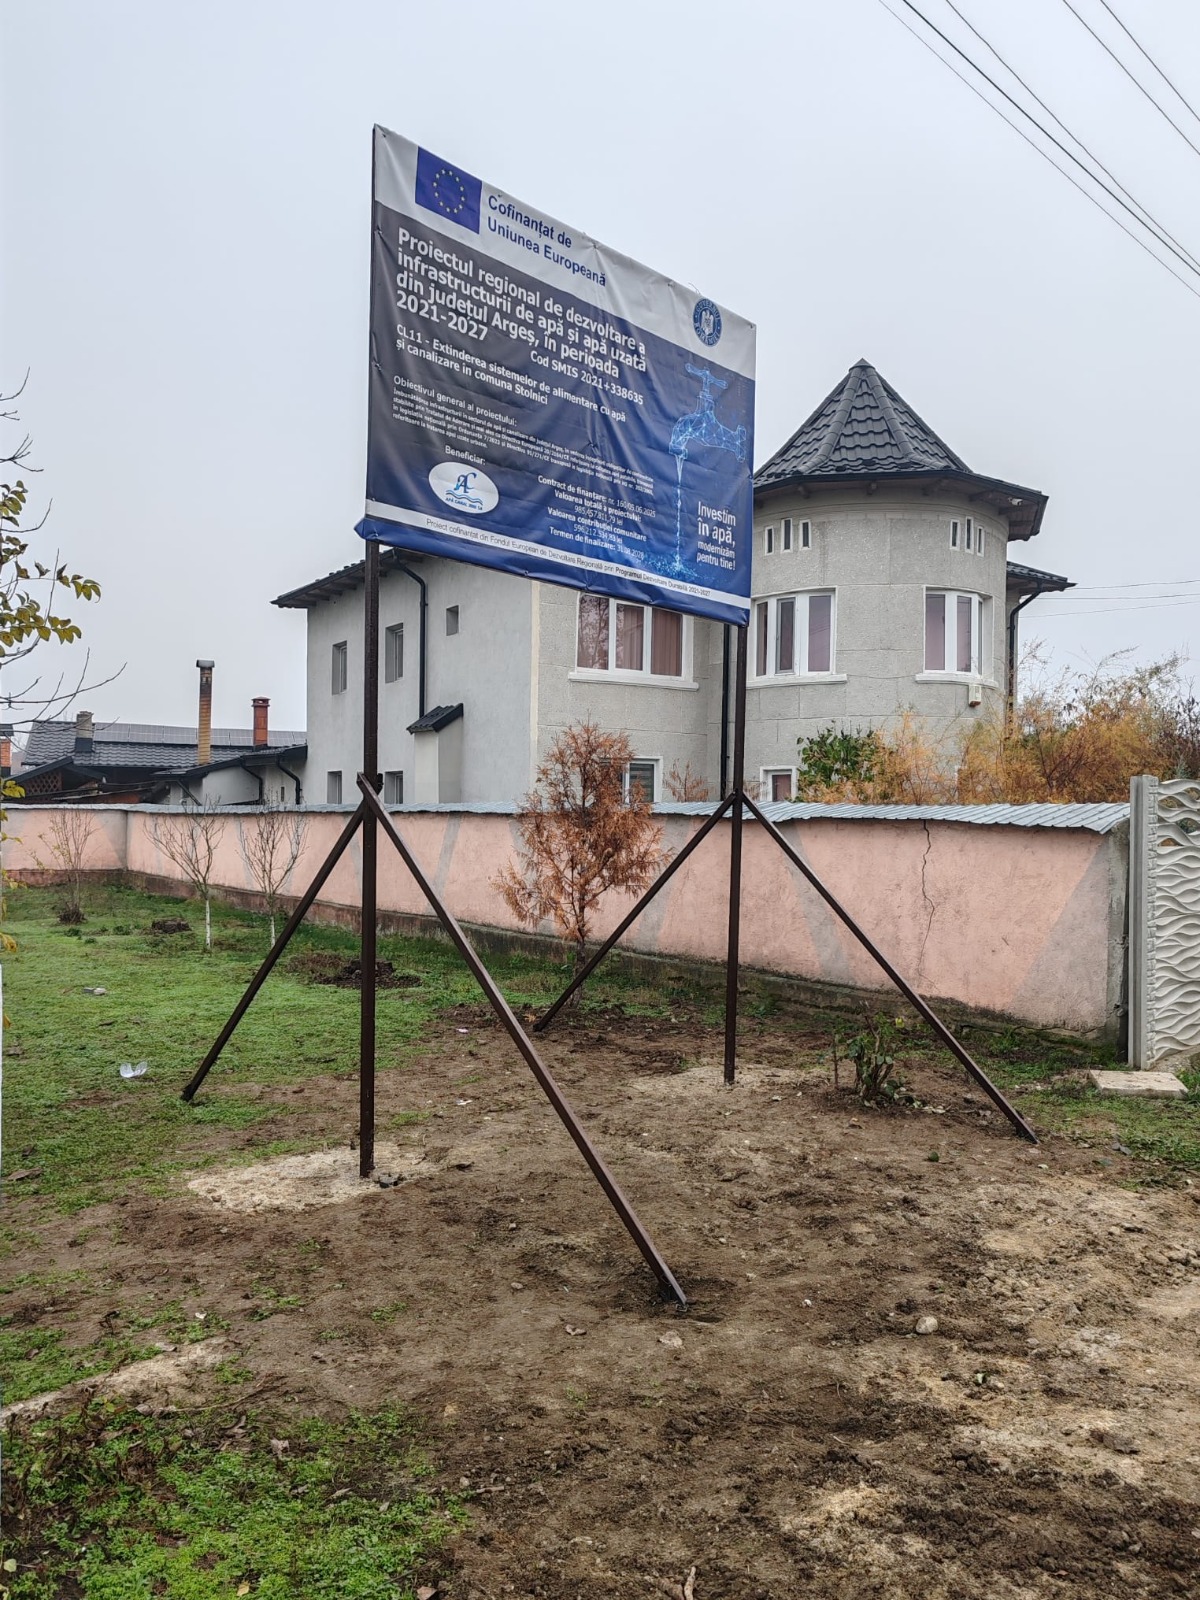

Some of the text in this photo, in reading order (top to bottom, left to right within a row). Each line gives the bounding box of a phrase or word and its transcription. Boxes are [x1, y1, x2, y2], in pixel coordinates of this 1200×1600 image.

[488, 195, 571, 248] Cofinanțat de
[487, 216, 605, 286] Uniunea Europeană
[397, 249, 646, 371] infrastructurii de apă și apă uzată
[398, 228, 472, 276] Proiectul
[478, 269, 540, 306] regional
[544, 297, 562, 317] de
[565, 308, 635, 349] dezvoltare
[396, 290, 488, 339] 2021-2027
[396, 270, 618, 377] din județul Argeș, în perioada
[396, 338, 404, 350] și
[407, 344, 460, 371] canalizare
[474, 370, 512, 391] comuna
[514, 383, 547, 404] Stolnici
[396, 323, 422, 343] CL11
[433, 339, 486, 368] Extinderea
[488, 363, 537, 387] sistemelor
[539, 381, 550, 394] de
[552, 387, 597, 411] alimentare
[599, 405, 609, 416] cu
[611, 410, 625, 422] apă
[530, 350, 643, 405] Cod SMIS 2021+338635
[393, 375, 434, 397] Obiectivul
[436, 392, 465, 408] general
[476, 406, 517, 426] proiectului:
[445, 445, 485, 465] Beneficiar:
[538, 475, 565, 490] Contract
[567, 484, 575, 493] de
[576, 486, 607, 503] finanțare:
[554, 489, 582, 504] Valoarea
[584, 498, 602, 510] totală
[698, 501, 736, 526] Investim
[426, 518, 447, 531] Proiect
[479, 533, 487, 541] din
[490, 535, 509, 547] Fondul
[511, 541, 538, 553] European
[615, 566, 641, 579] Programul
[547, 507, 575, 521] Valoarea
[613, 527, 646, 542] comunitare
[549, 526, 573, 540] Termen
[575, 533, 583, 543] de
[584, 535, 615, 550] finalizare:
[697, 517, 735, 547] în apă,
[697, 540, 734, 558] modernizăm
[696, 552, 735, 570] pentru tine!
